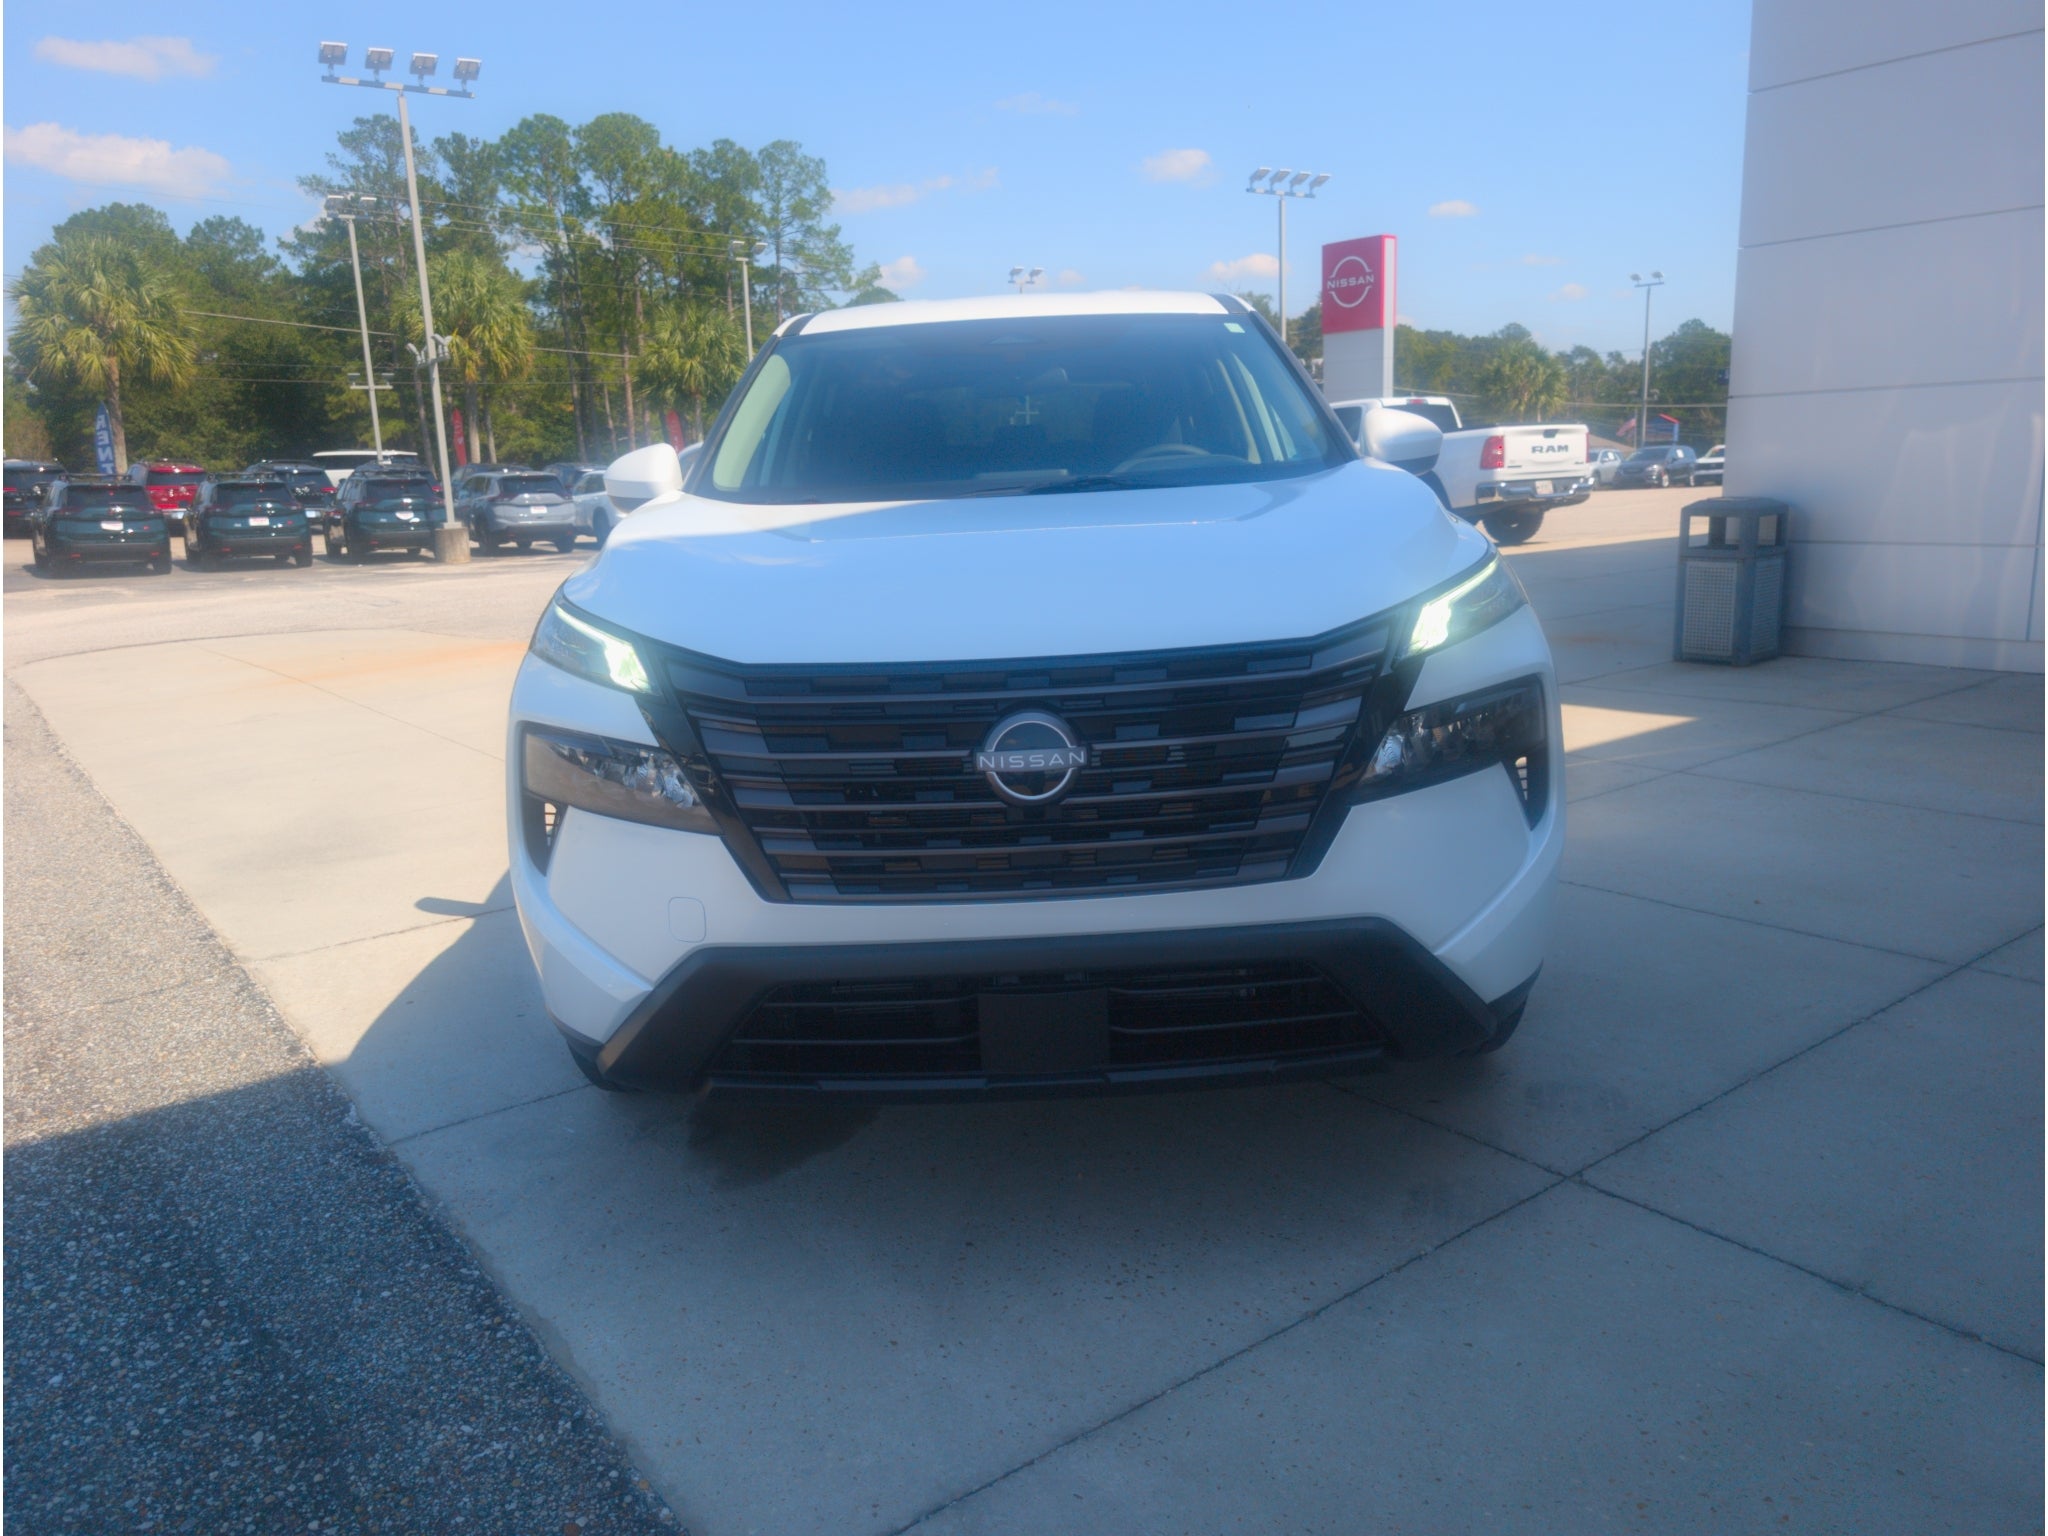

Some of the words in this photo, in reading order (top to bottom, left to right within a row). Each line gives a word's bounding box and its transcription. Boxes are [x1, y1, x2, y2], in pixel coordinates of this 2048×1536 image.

[1327, 274, 1374, 289] NISSAN
[1531, 444, 1569, 454] RAM
[980, 751, 1085, 769] NISSAN
